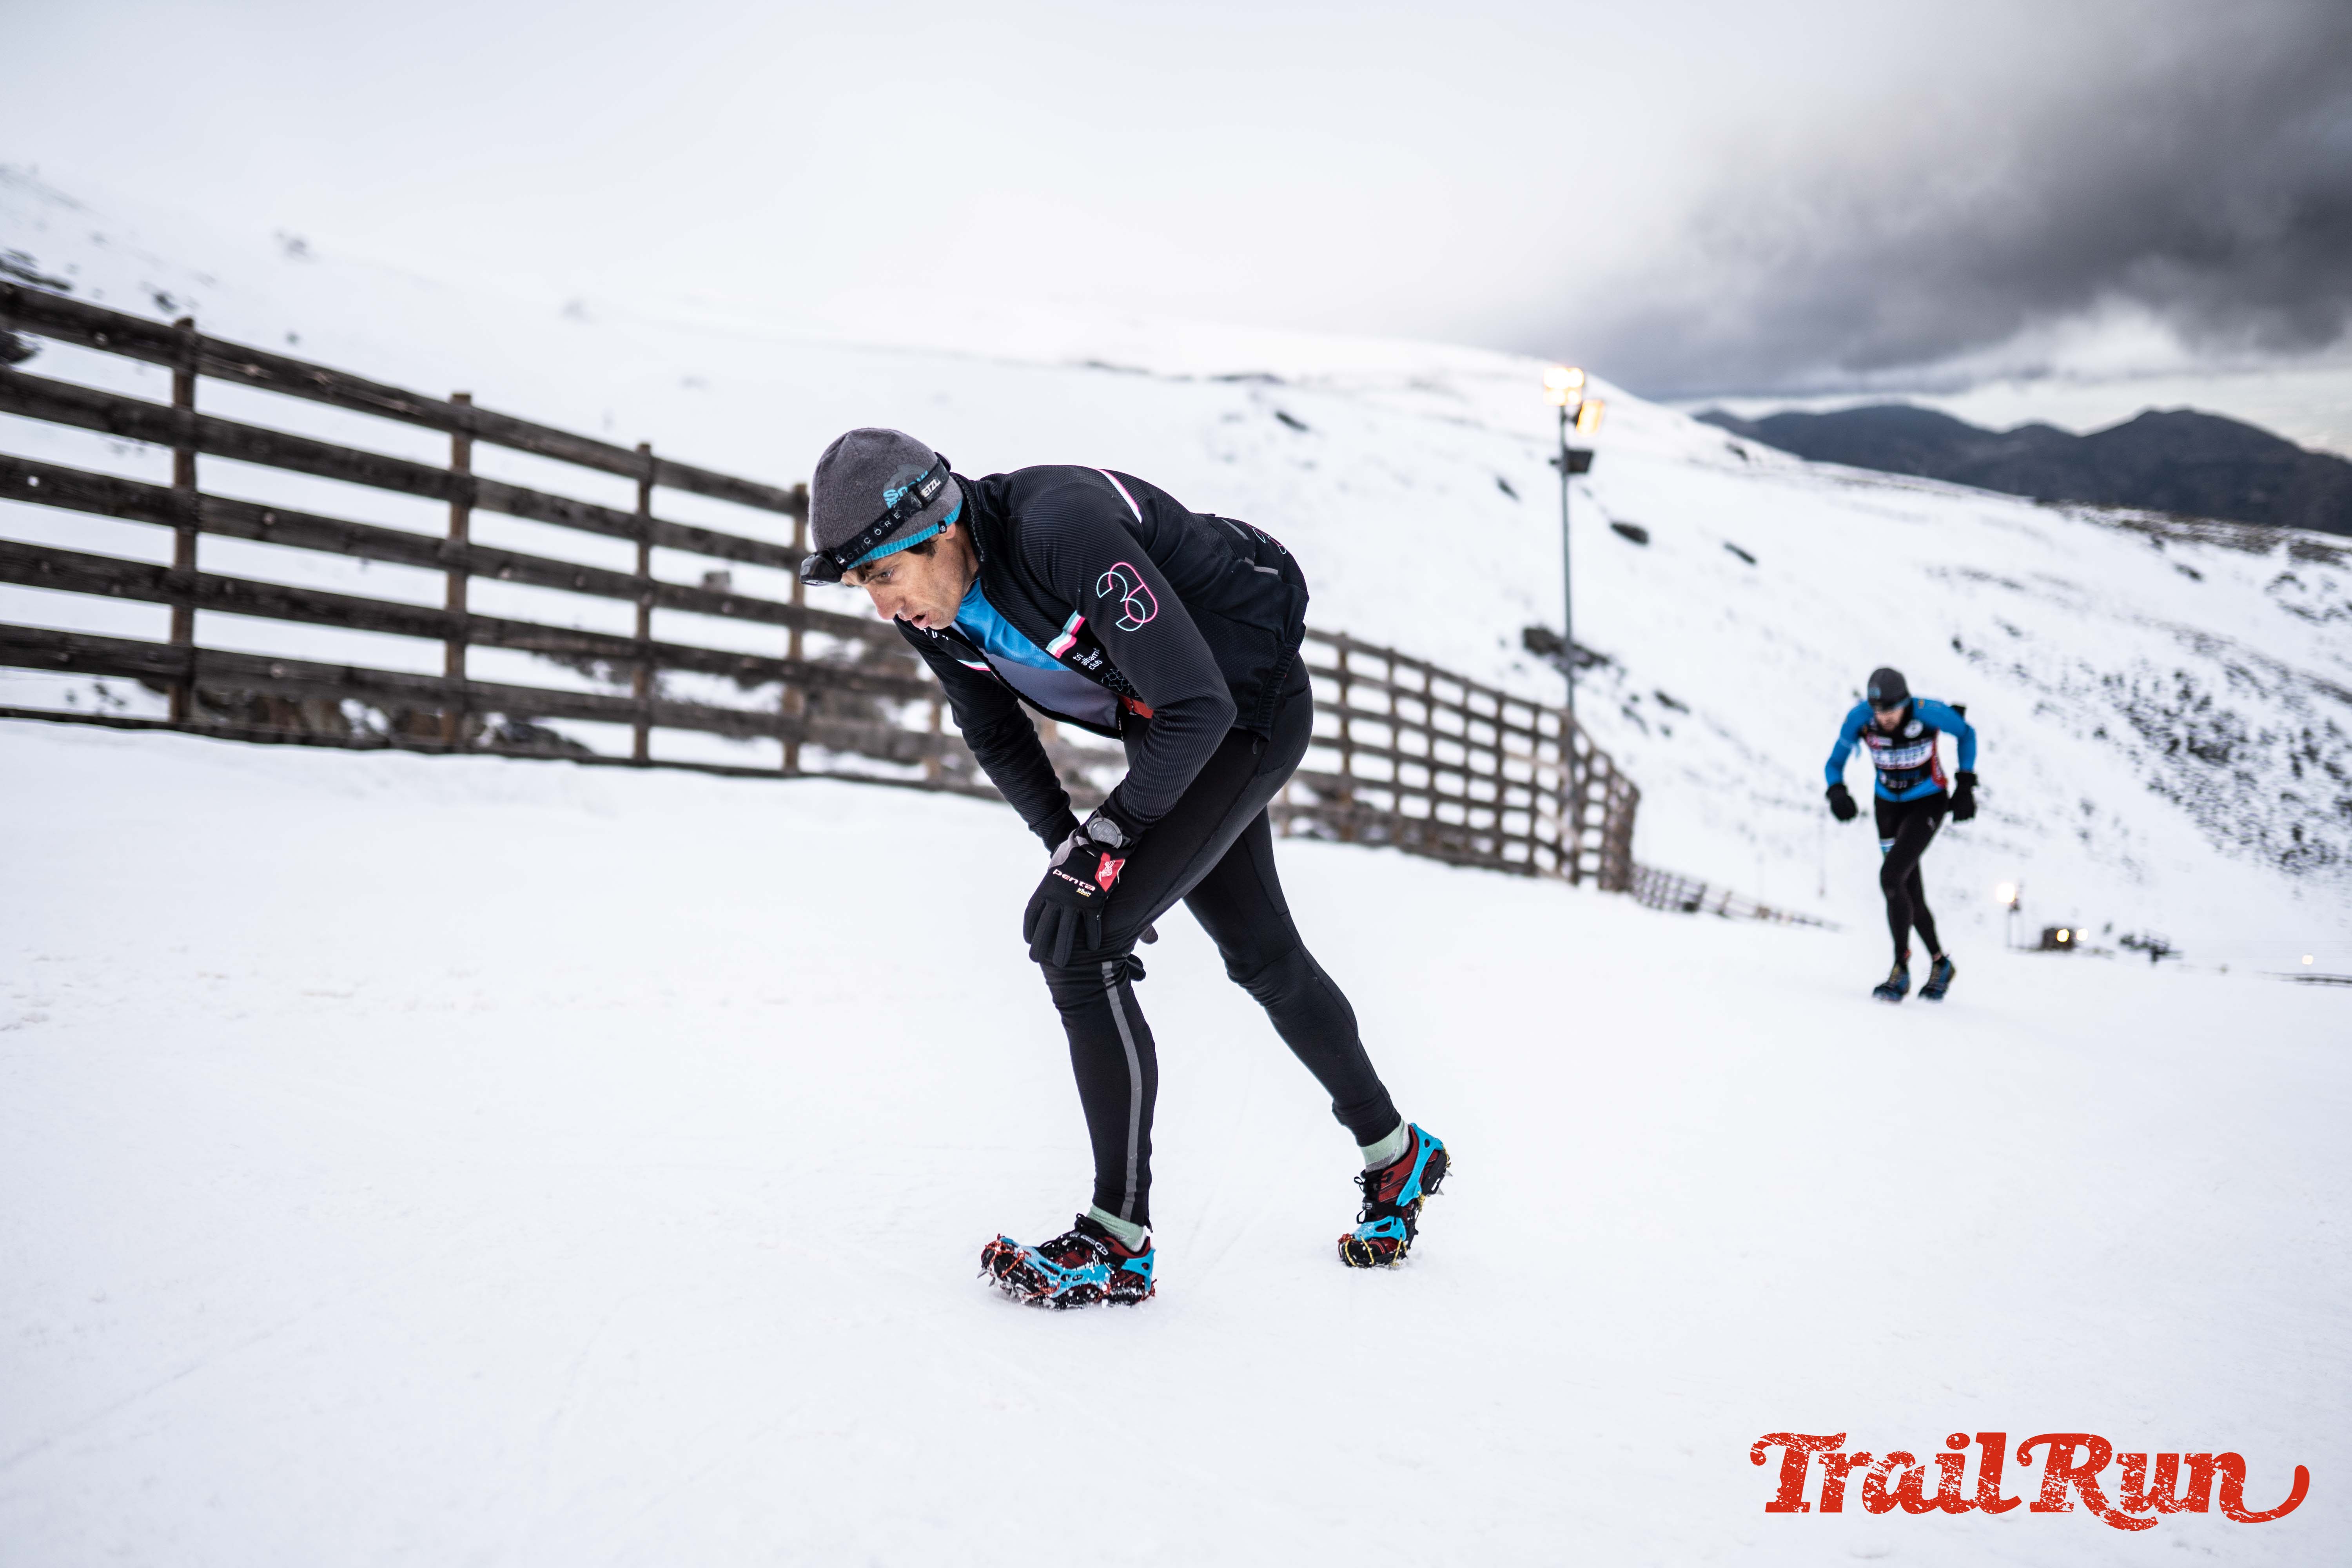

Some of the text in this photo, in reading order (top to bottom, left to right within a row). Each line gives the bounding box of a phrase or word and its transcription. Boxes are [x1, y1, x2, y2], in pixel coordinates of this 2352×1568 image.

[920, 479, 941, 497] ETZL
[864, 512, 900, 544] CORE
[1089, 660, 1102, 670] club
